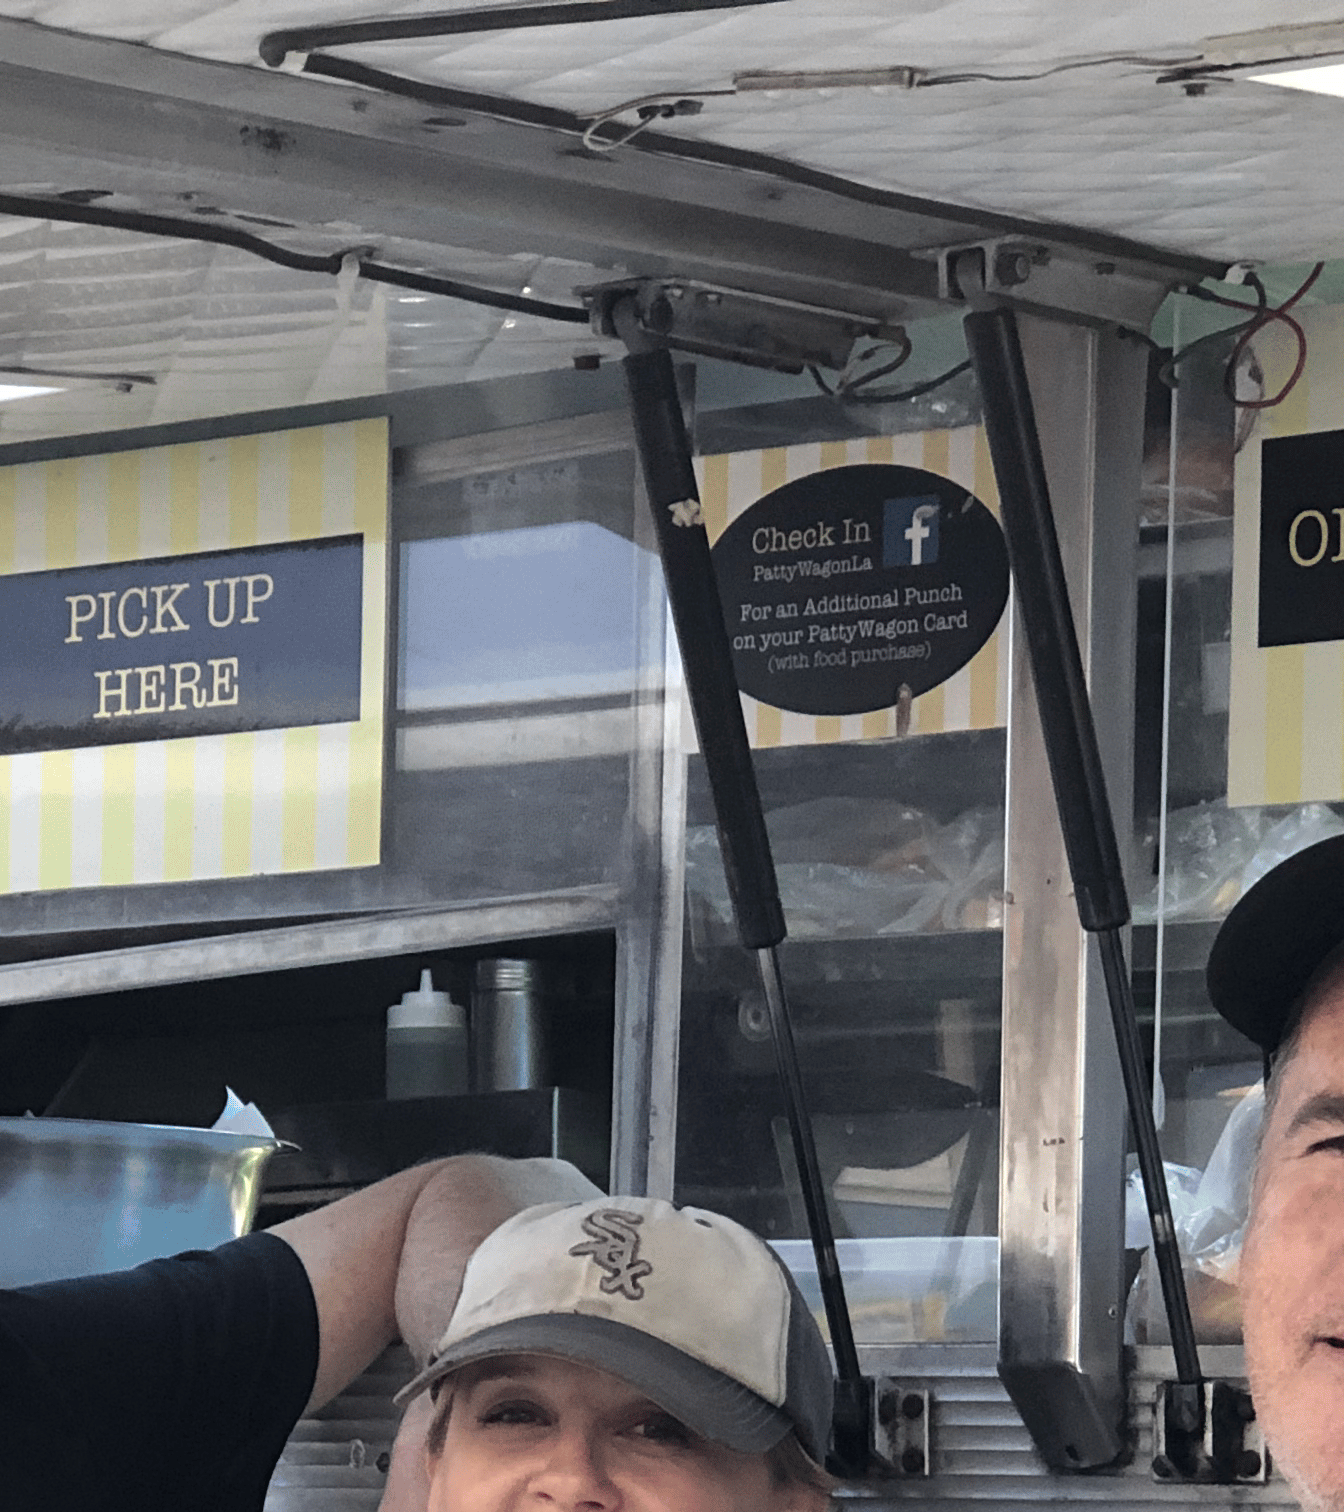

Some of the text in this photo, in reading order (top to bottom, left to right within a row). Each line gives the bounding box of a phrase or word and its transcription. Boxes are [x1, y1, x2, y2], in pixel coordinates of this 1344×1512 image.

[751, 517, 872, 555] Check In
[63, 573, 275, 643] PICK UP
[740, 583, 963, 622] For an Additional Punch
[733, 610, 968, 653] on your PattyWagon Card
[767, 640, 932, 674] (with food purchase)
[93, 656, 240, 719] HERE
